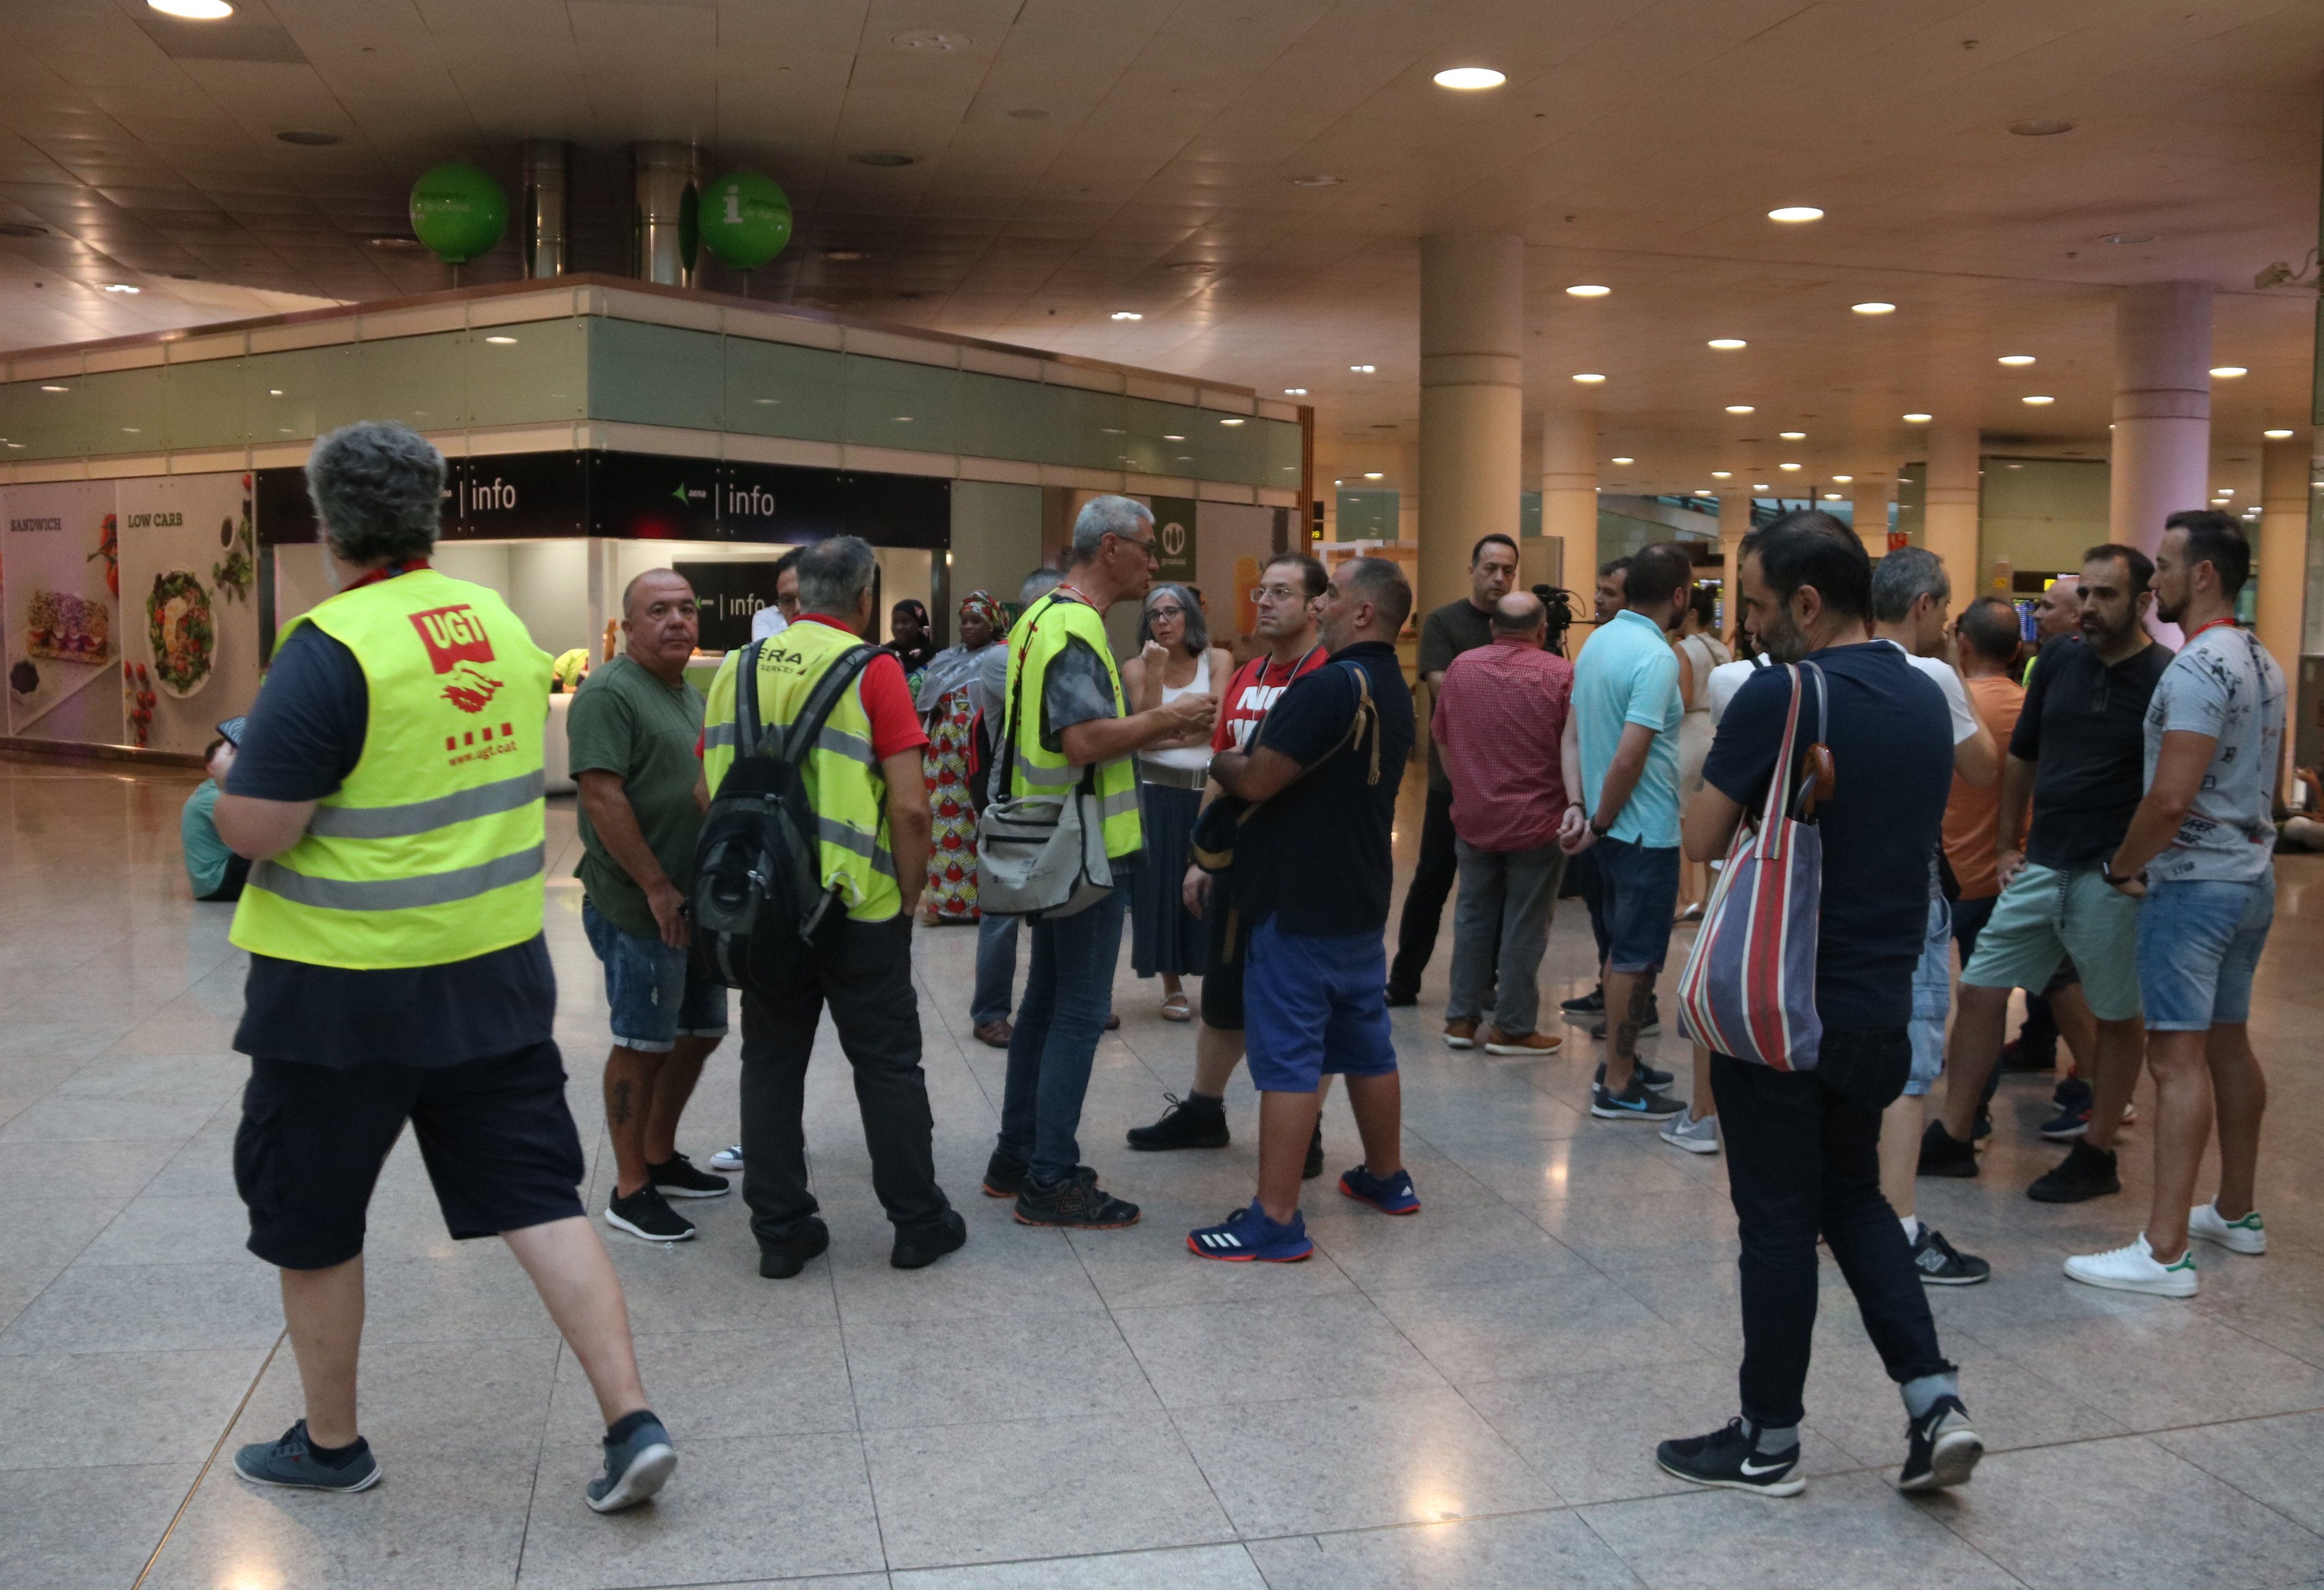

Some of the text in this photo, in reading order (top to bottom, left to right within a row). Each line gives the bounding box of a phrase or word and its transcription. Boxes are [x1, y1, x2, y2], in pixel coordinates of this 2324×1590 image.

[472, 477, 516, 509] info
[730, 483, 774, 516] info
[10, 517, 61, 532] SANDWICH
[127, 513, 183, 528] LOW CARB
[421, 609, 486, 649] UGT
